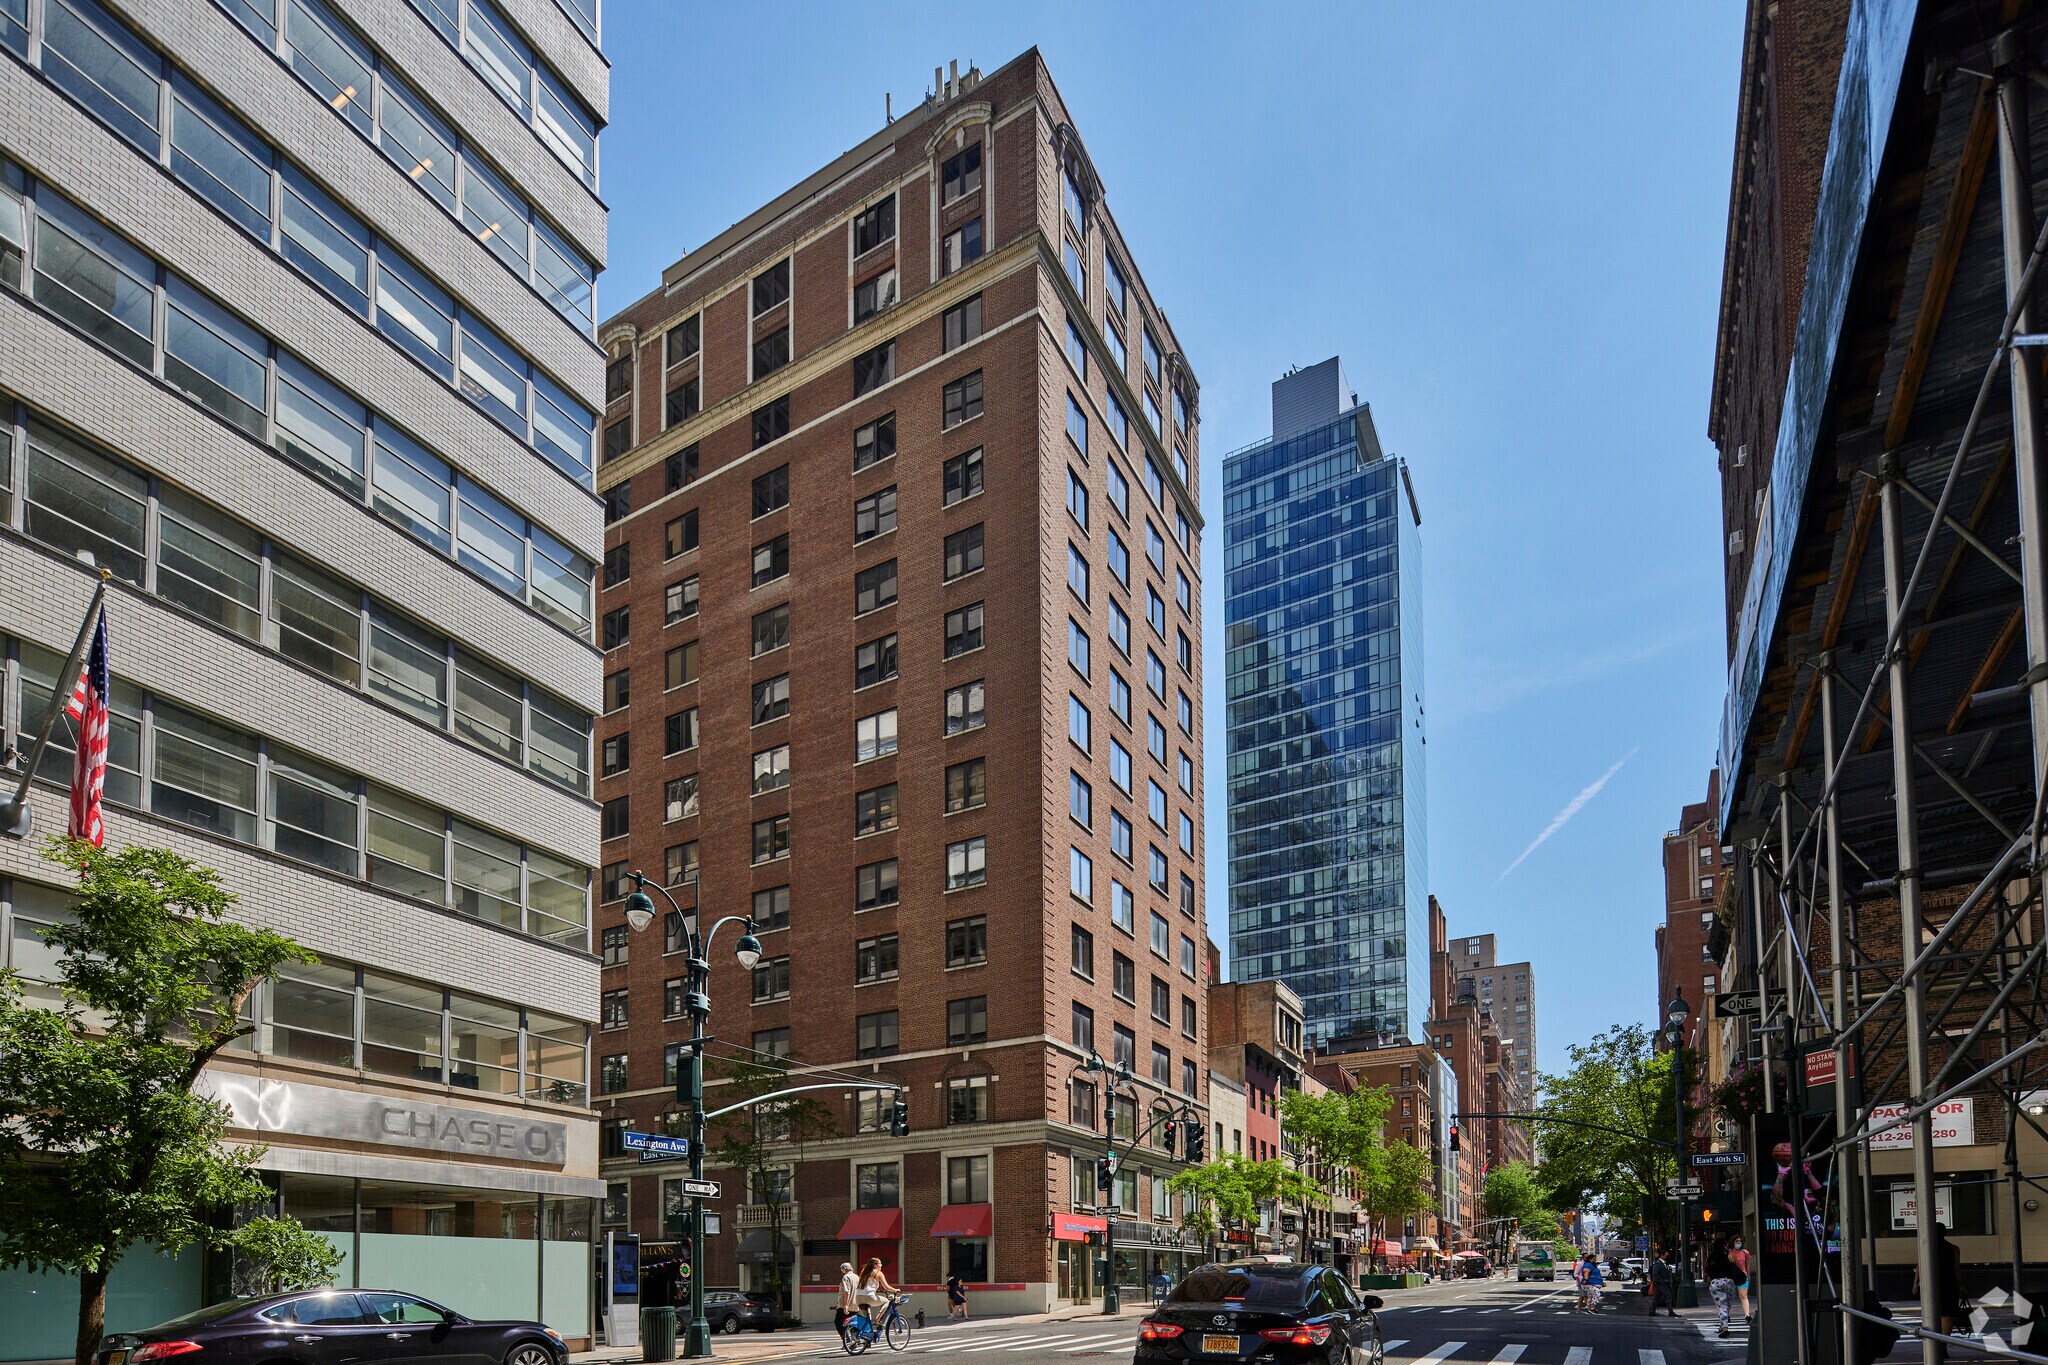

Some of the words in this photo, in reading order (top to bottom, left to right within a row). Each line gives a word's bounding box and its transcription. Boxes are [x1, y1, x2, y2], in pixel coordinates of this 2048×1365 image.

[1728, 998, 1753, 1010] ONE
[1807, 1056, 1816, 1064] NO
[1807, 1061, 1833, 1071] Anytime
[380, 1107, 515, 1149] CHASE
[627, 1135, 669, 1150] Lexington
[670, 1143, 686, 1151] Ave
[703, 1184, 715, 1192] WAY
[1765, 1218, 1784, 1230] THIS
[1786, 1217, 1795, 1229] IS
[1779, 1229, 1795, 1241] FOR
